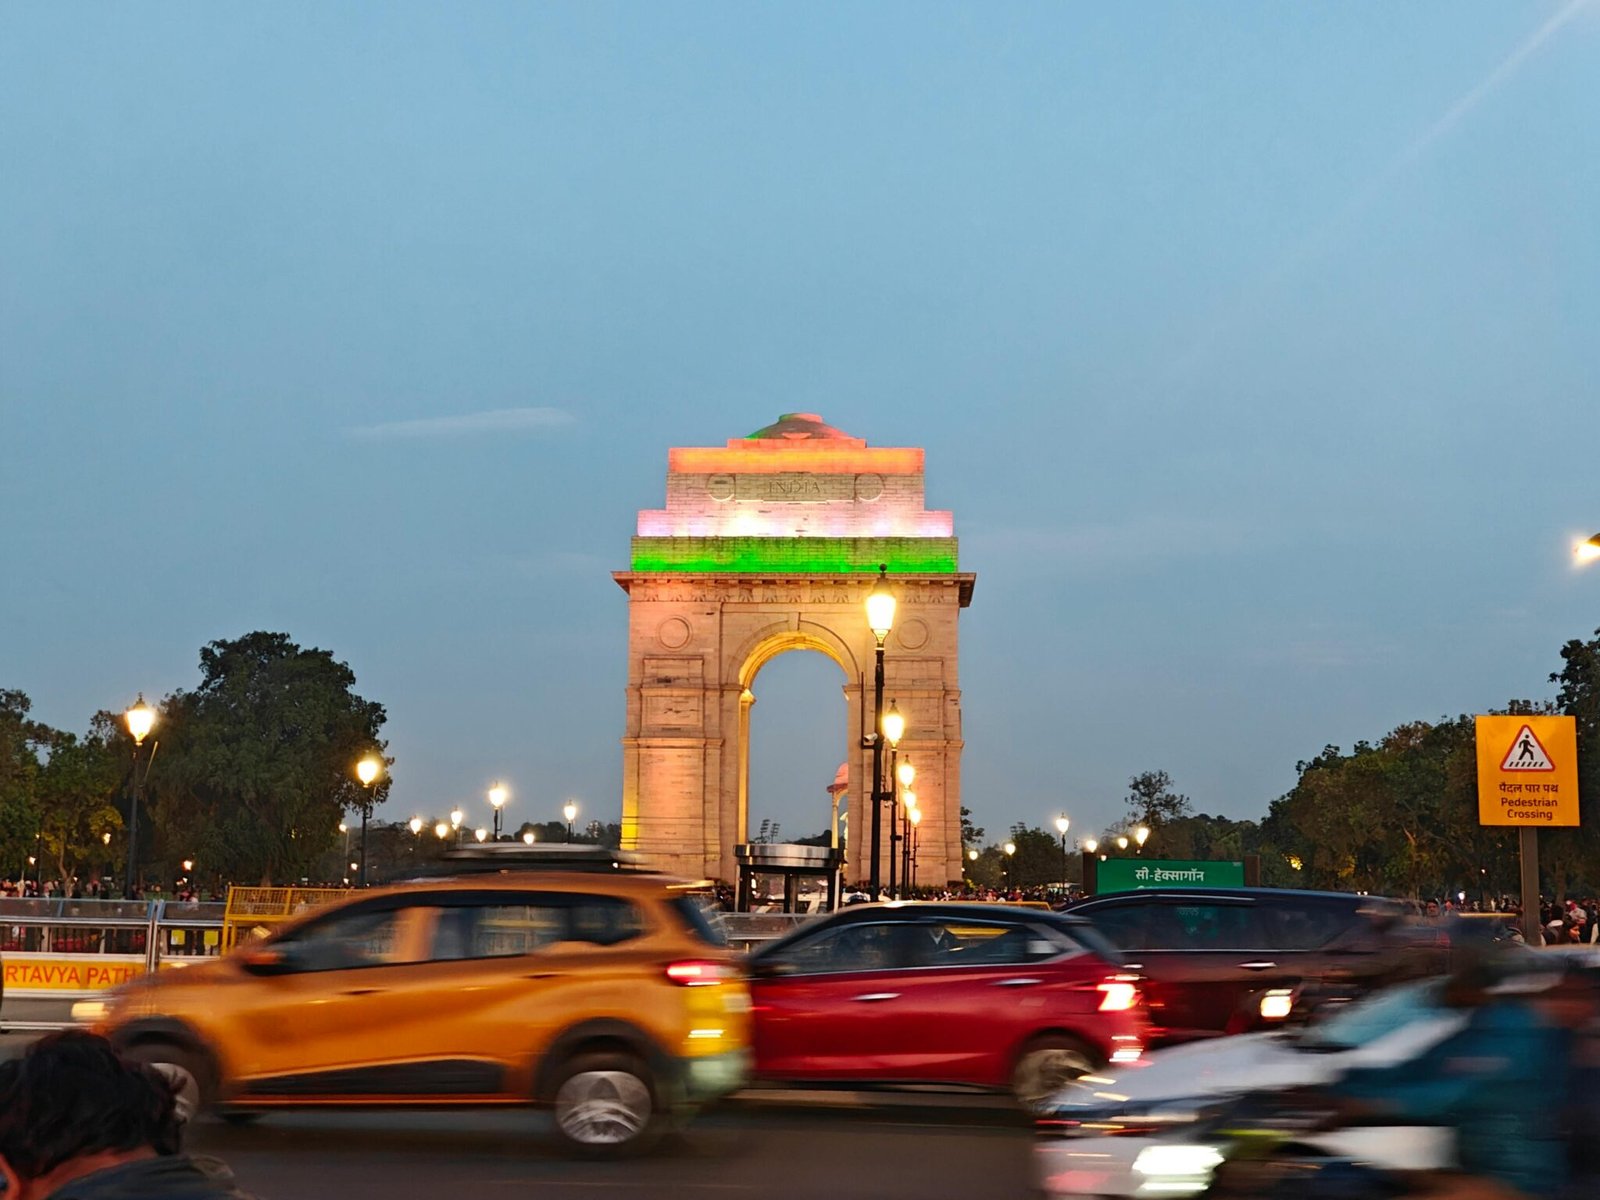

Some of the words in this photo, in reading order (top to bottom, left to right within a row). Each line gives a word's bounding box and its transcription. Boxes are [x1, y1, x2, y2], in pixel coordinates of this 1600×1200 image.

[769, 480, 821, 494] INDIA
[1525, 784, 1540, 793] पार
[1543, 784, 1559, 793] पथ
[1501, 798, 1558, 807] Pedestrian
[1507, 809, 1553, 820] Crossing
[87, 967, 137, 984] PATH
